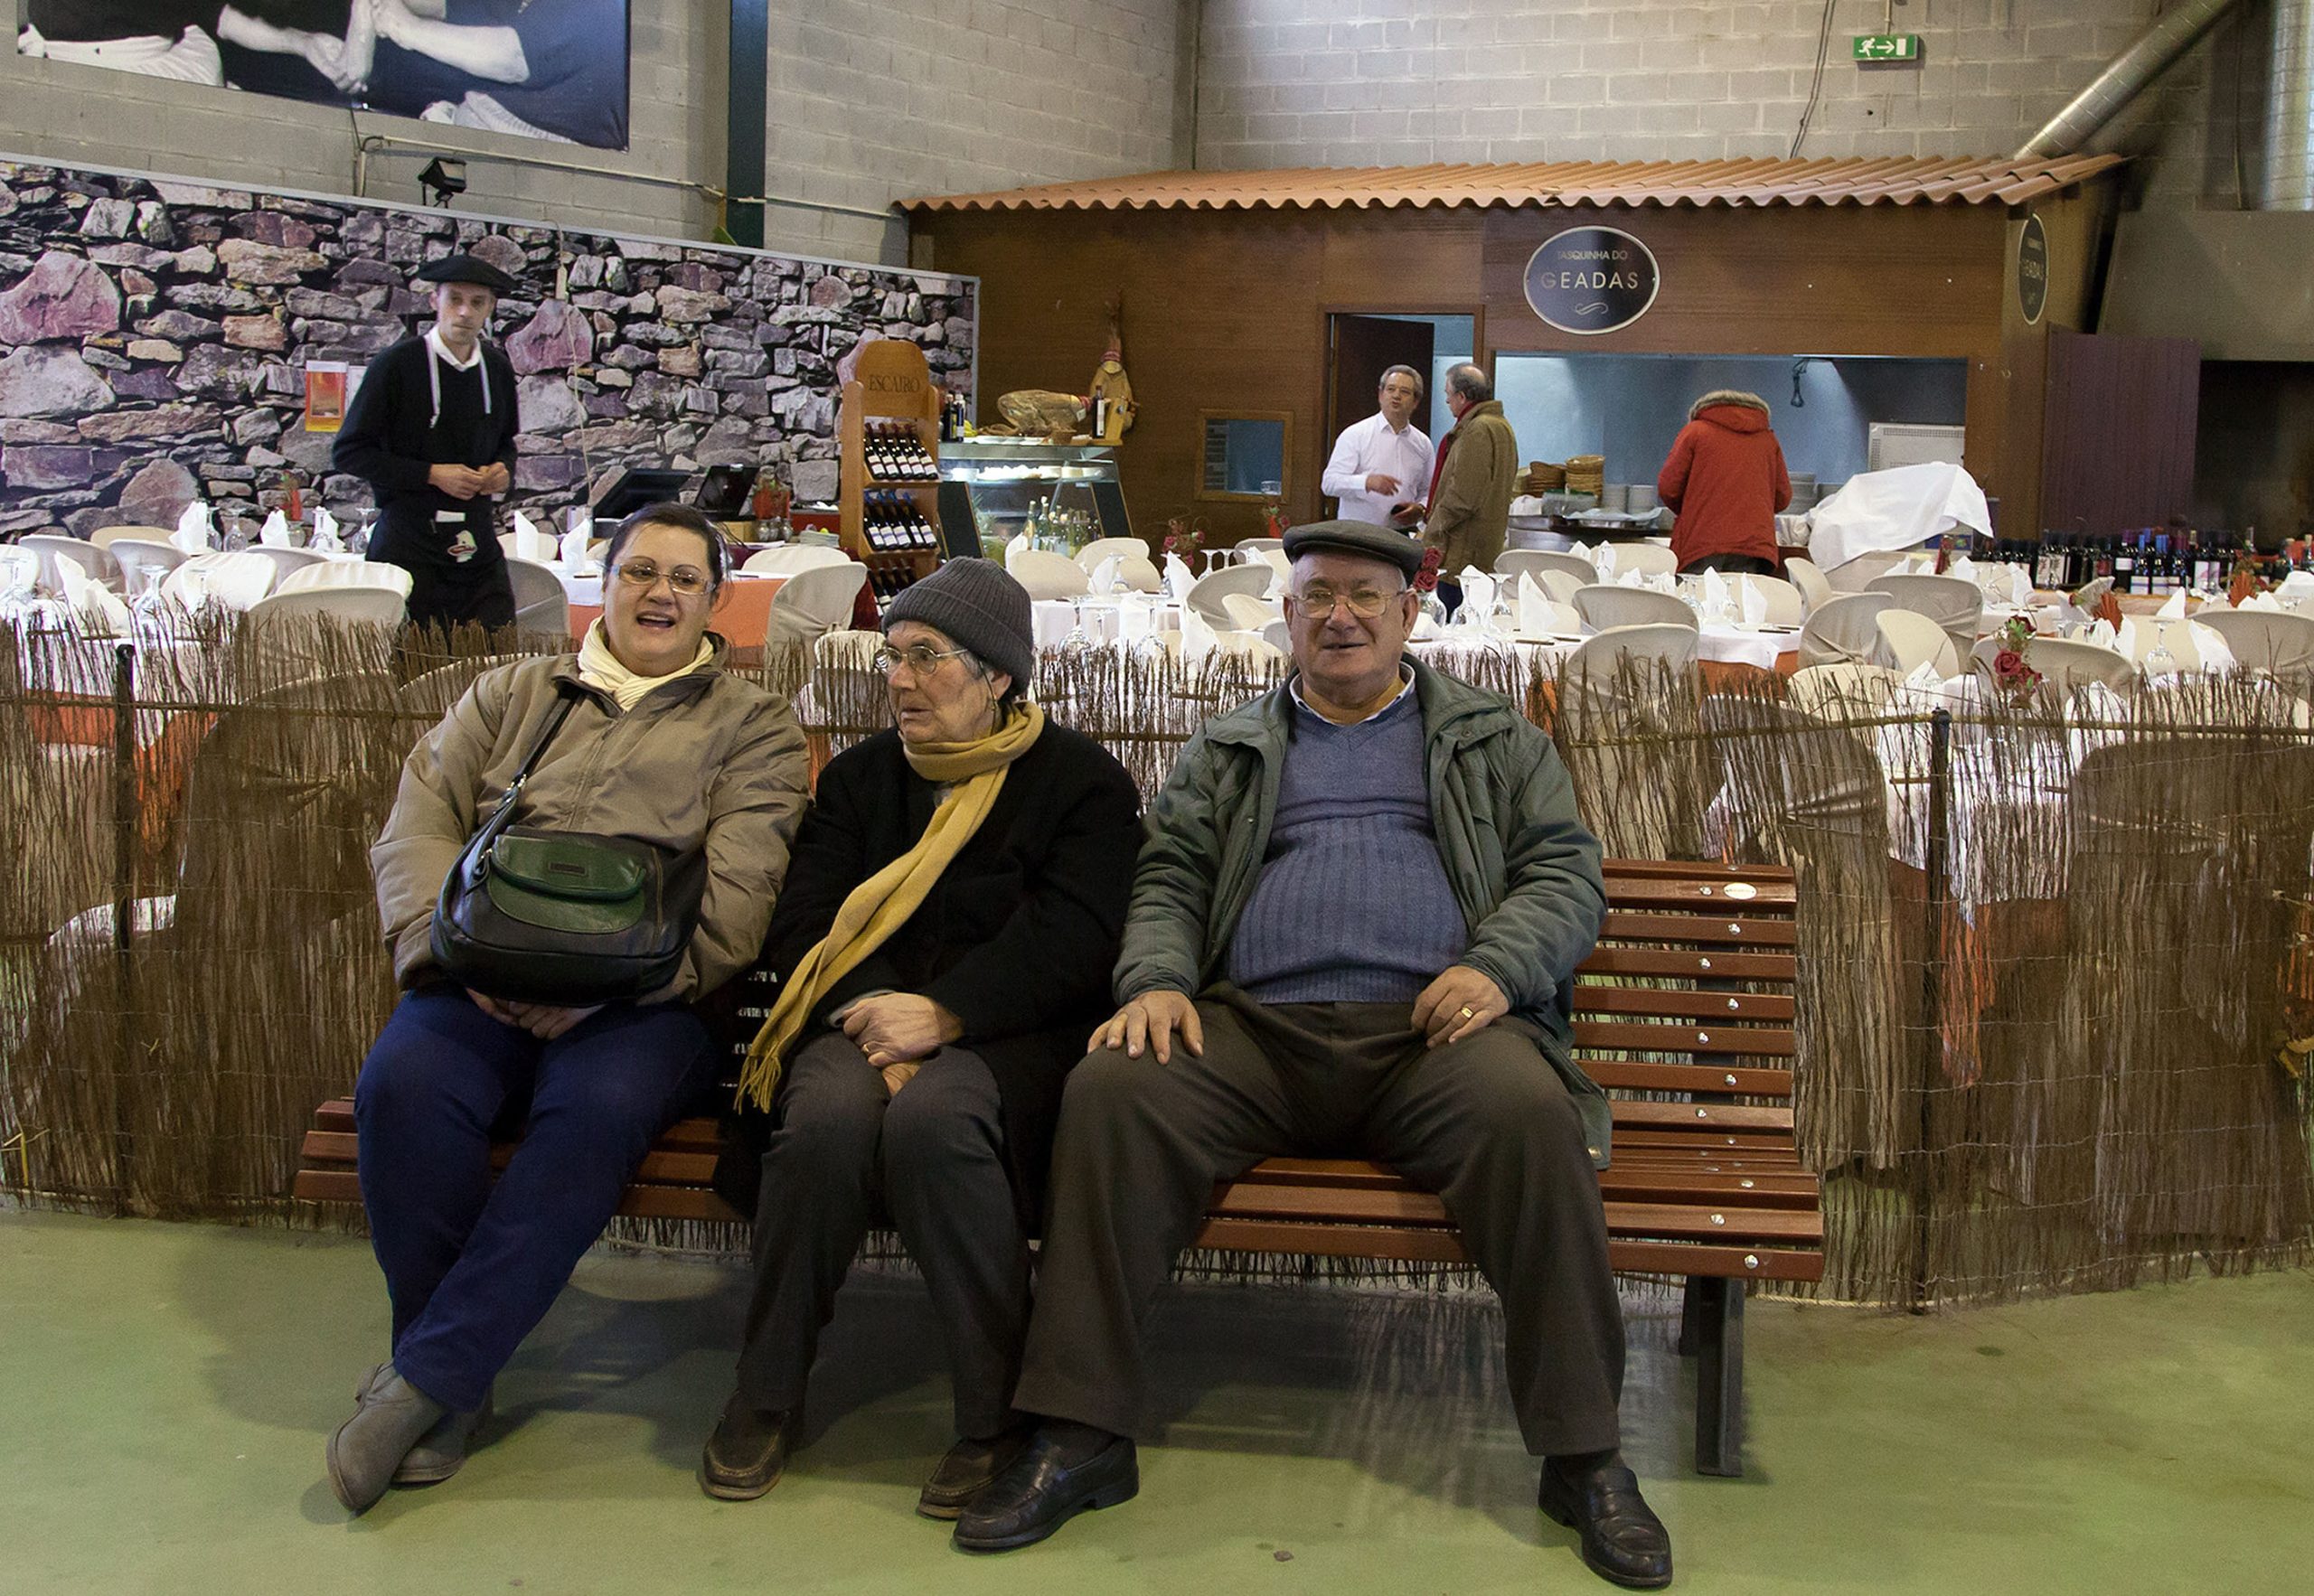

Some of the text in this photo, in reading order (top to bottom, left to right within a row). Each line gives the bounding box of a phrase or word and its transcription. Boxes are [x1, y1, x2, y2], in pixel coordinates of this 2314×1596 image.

[1612, 250, 1628, 260] DO
[1540, 271, 1639, 289] GEADAS
[869, 374, 920, 393] ESCAIRO
